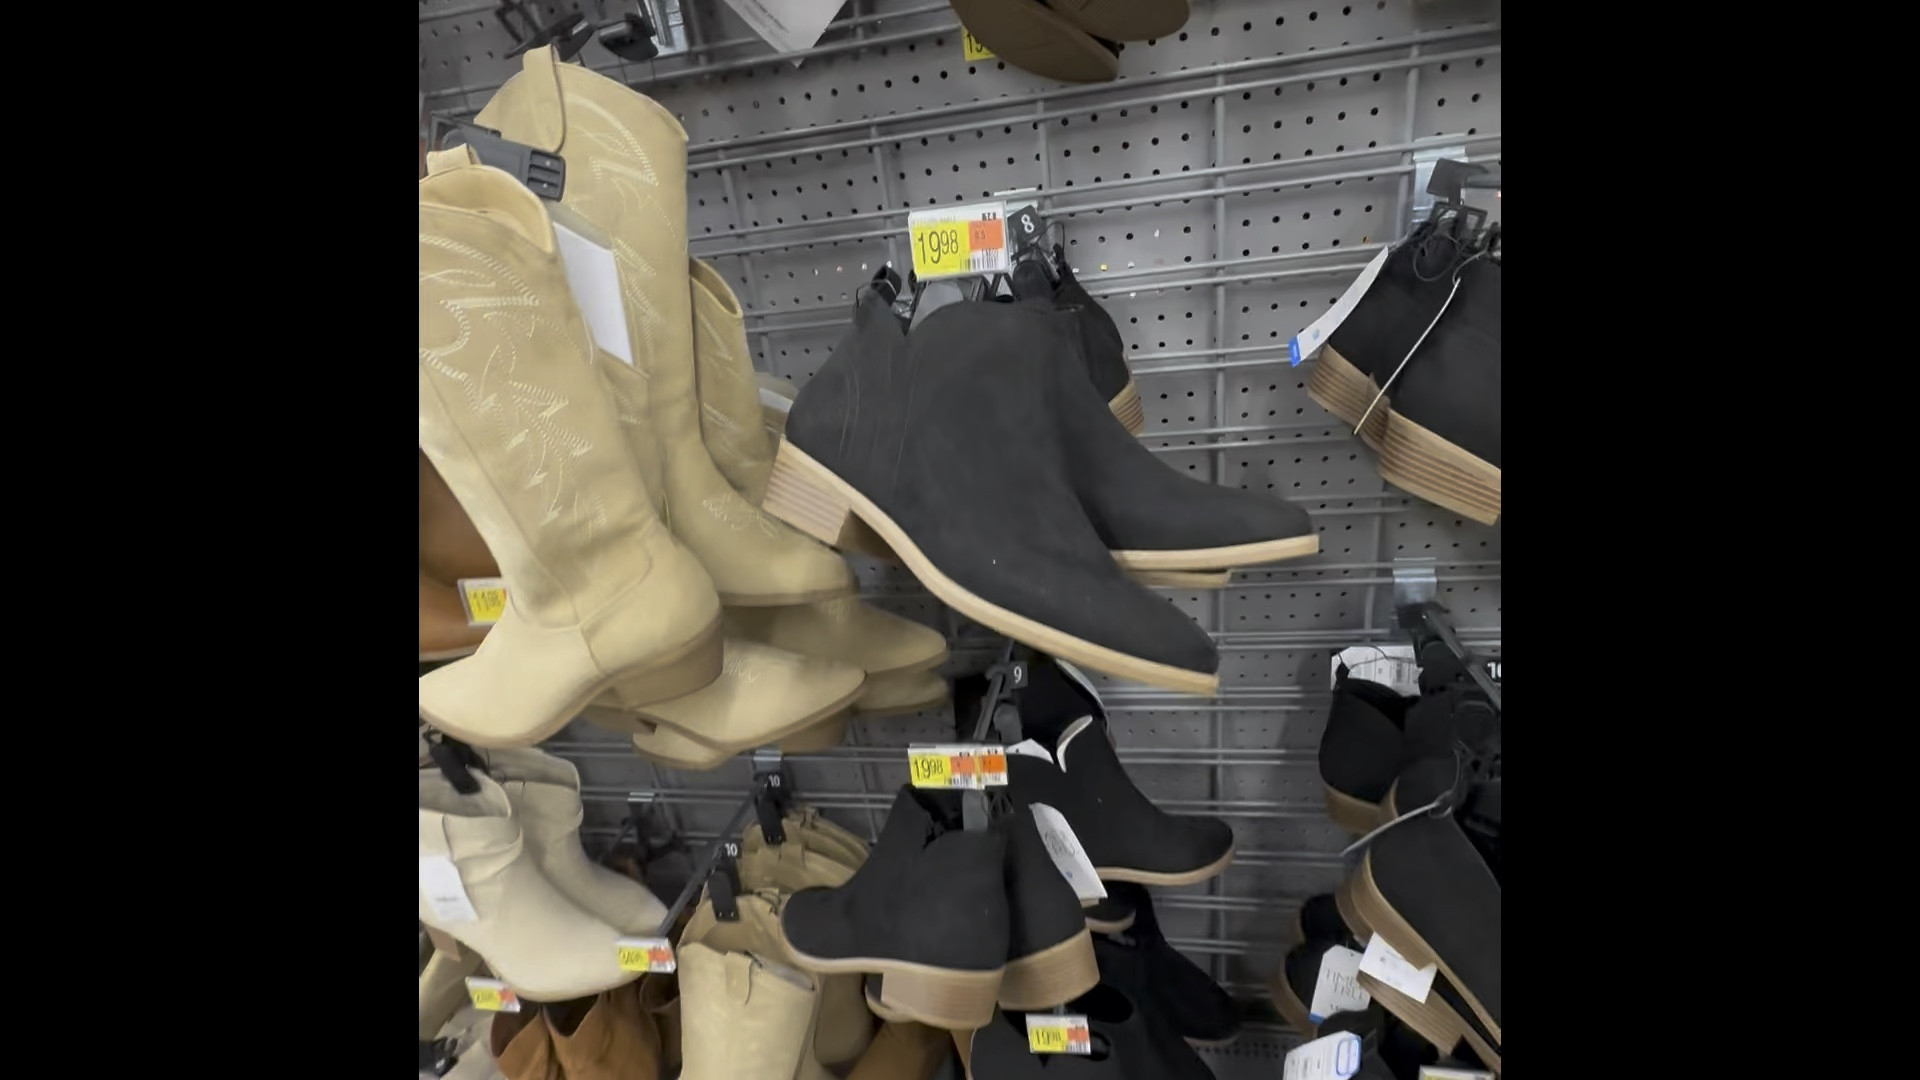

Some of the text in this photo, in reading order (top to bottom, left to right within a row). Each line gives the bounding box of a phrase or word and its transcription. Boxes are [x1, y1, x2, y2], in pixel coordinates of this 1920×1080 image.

[1021, 214, 1035, 233] 8
[1013, 665, 1022, 684] 9
[768, 774, 780, 787] 10
[725, 842, 738, 857] 10
